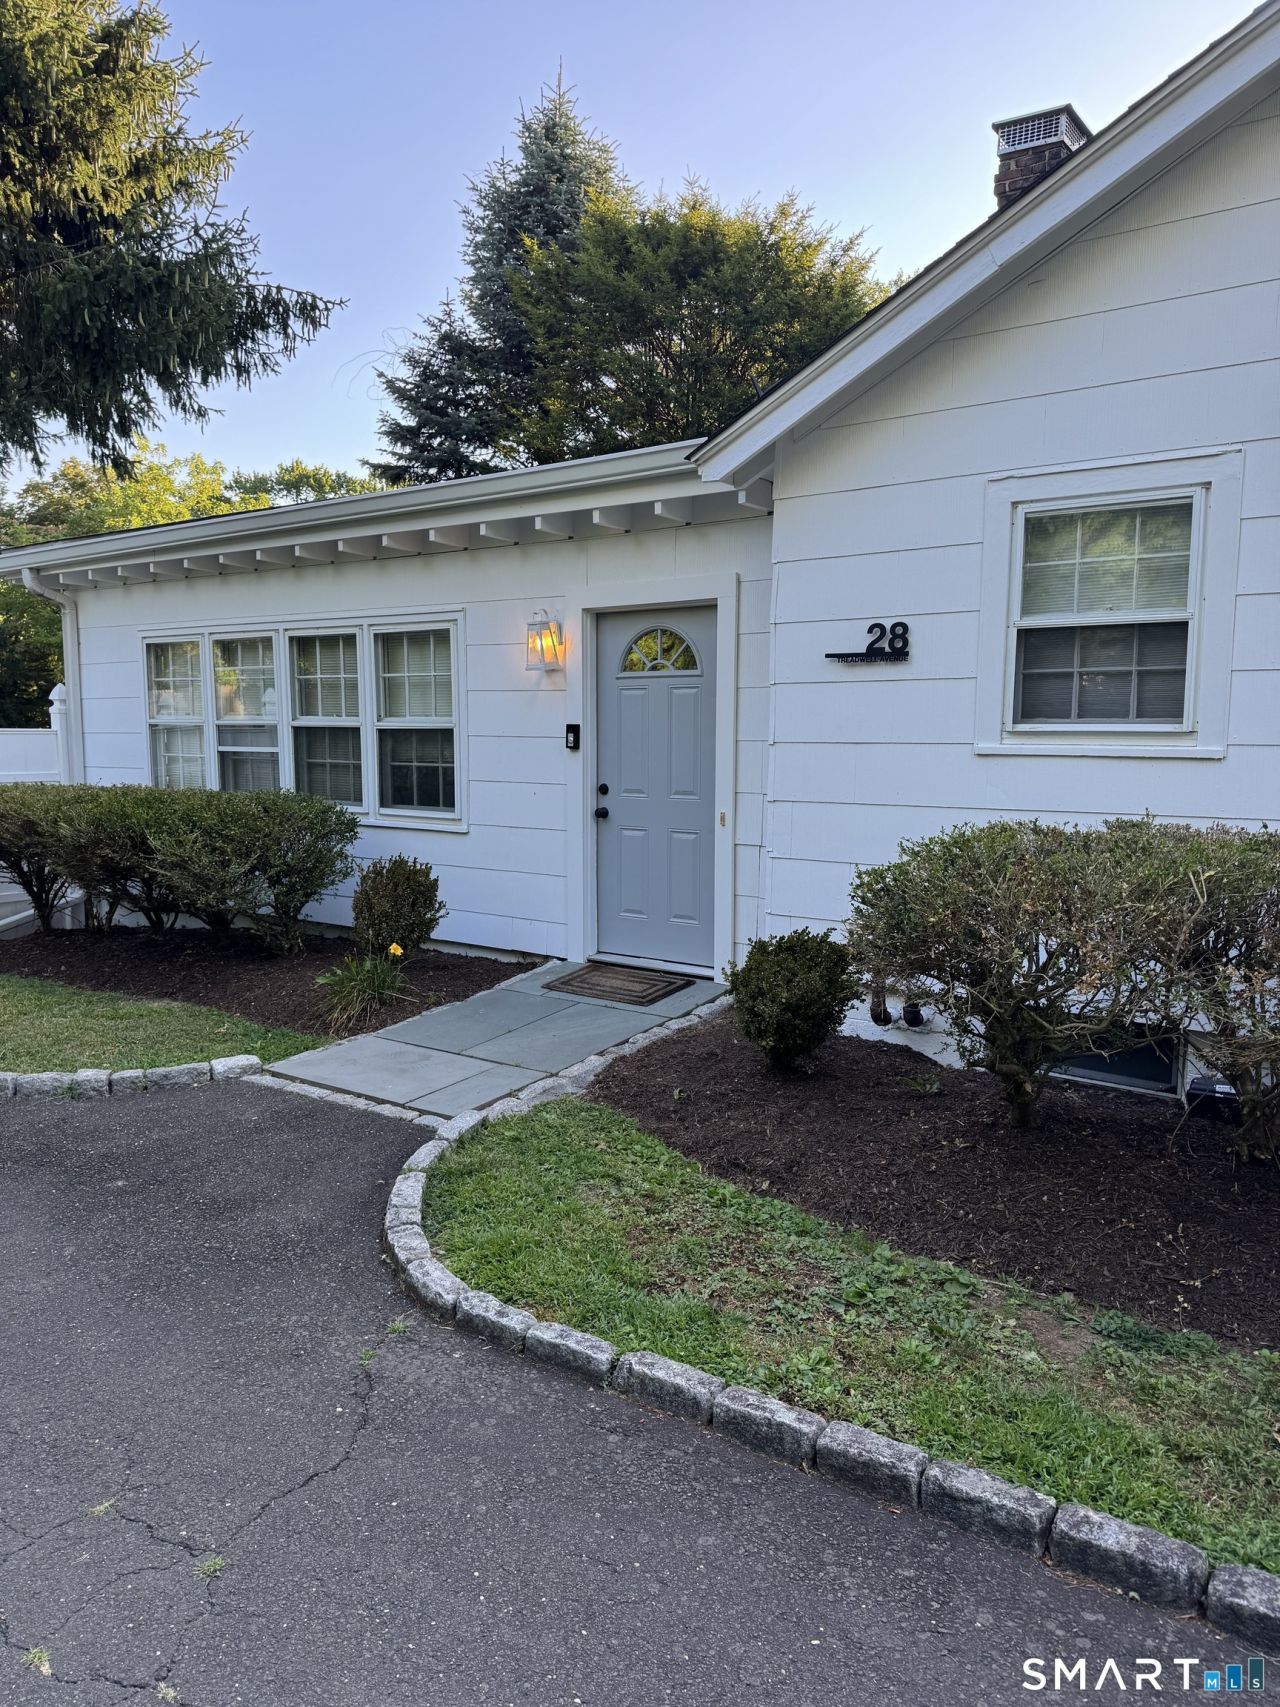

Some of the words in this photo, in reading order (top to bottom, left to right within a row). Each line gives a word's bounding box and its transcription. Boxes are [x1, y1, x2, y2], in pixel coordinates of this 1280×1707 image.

[865, 621, 909, 655] 28
[837, 655, 878, 664] TREADWELL
[879, 655, 909, 663] AVENUE
